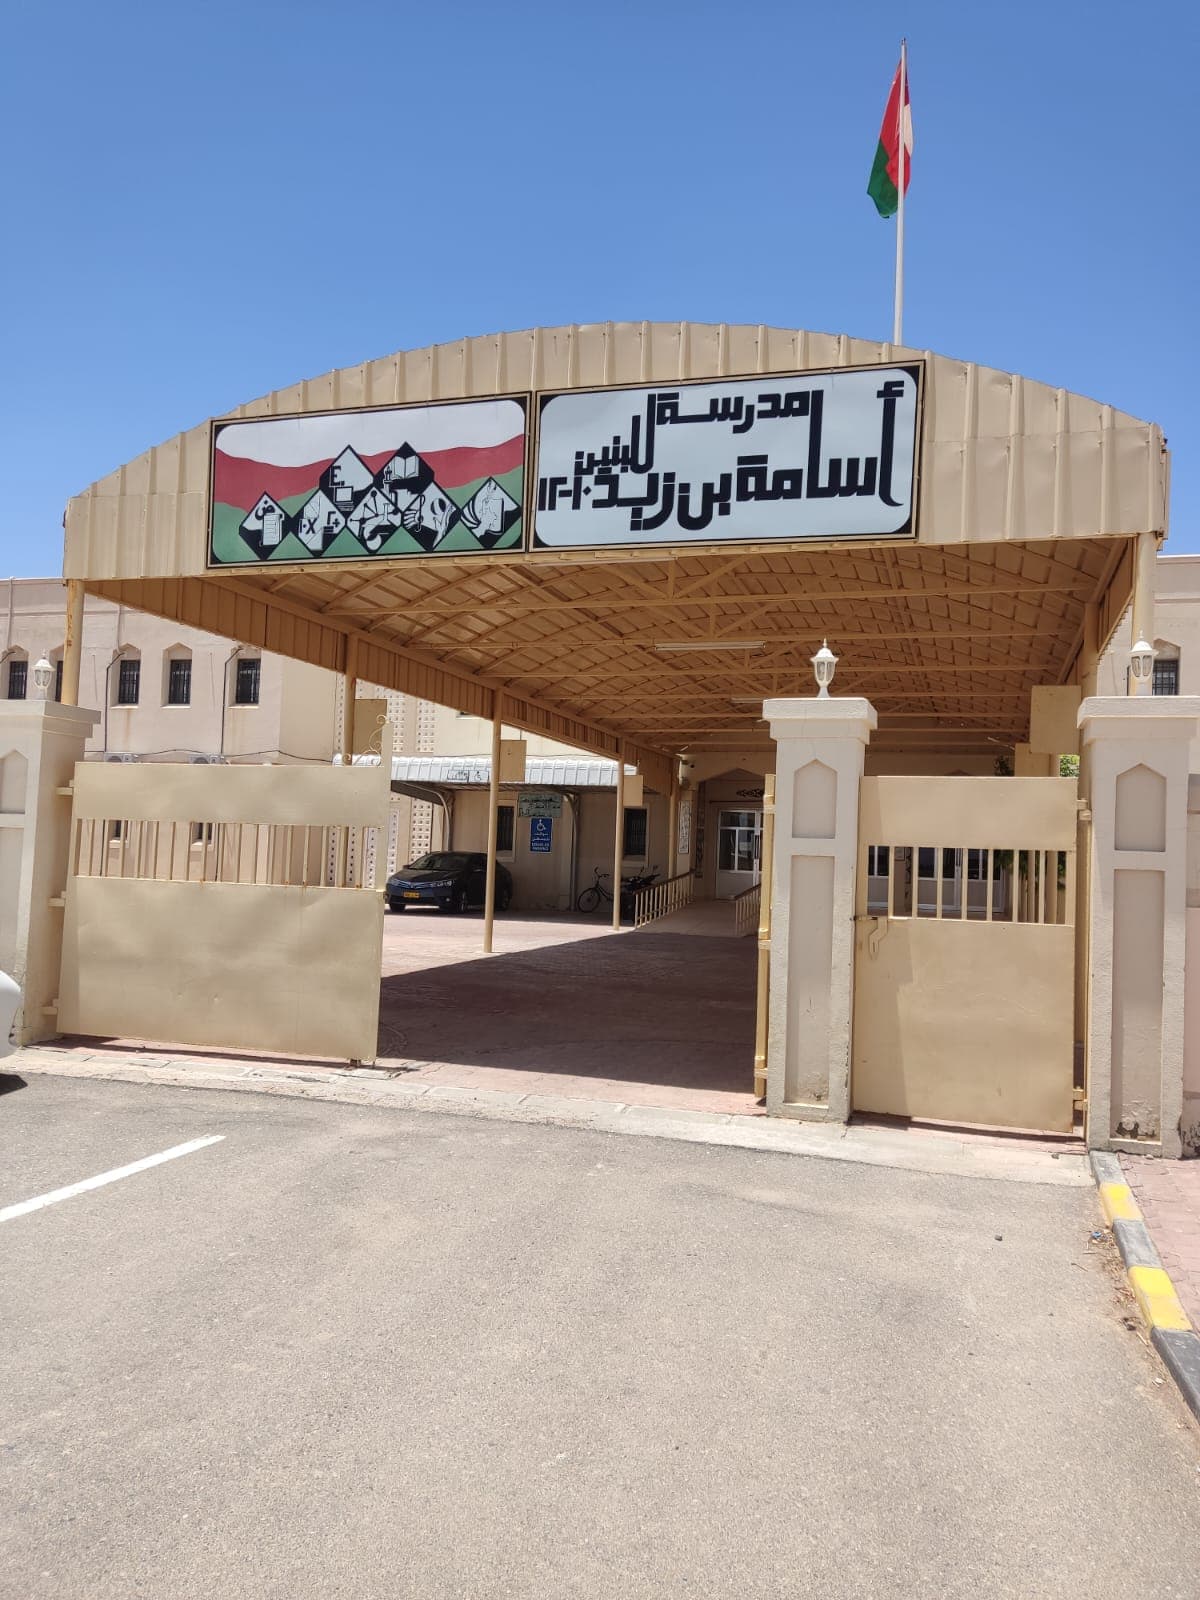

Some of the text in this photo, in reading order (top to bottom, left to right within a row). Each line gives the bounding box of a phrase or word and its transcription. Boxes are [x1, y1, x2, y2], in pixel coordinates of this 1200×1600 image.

[574, 393, 656, 476] للبنين
[656, 391, 811, 434] مدرسة
[592, 380, 905, 531] أسامة بن زيد
